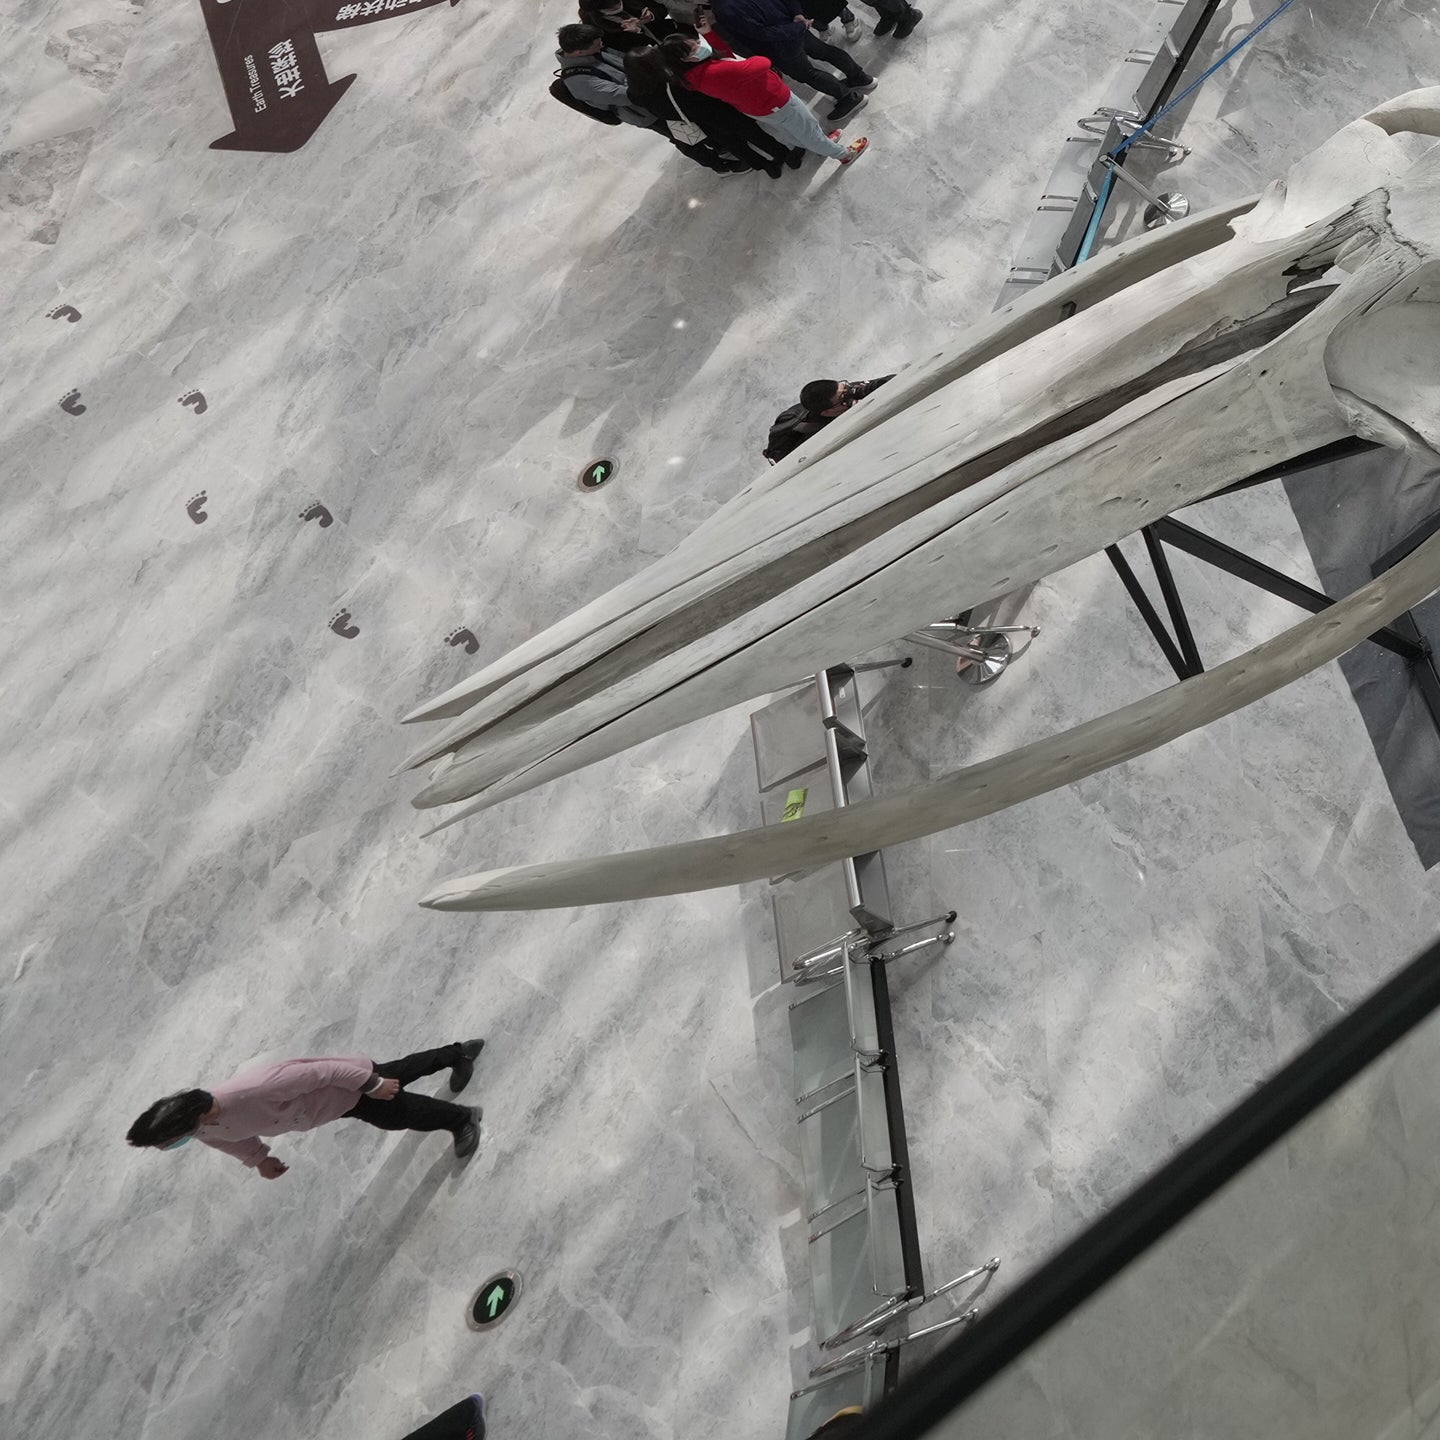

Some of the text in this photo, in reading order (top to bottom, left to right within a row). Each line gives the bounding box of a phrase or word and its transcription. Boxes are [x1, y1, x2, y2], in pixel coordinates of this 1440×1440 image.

[244, 54, 267, 113] Earth Treasures
[268, 38, 305, 100] 大地探珍
